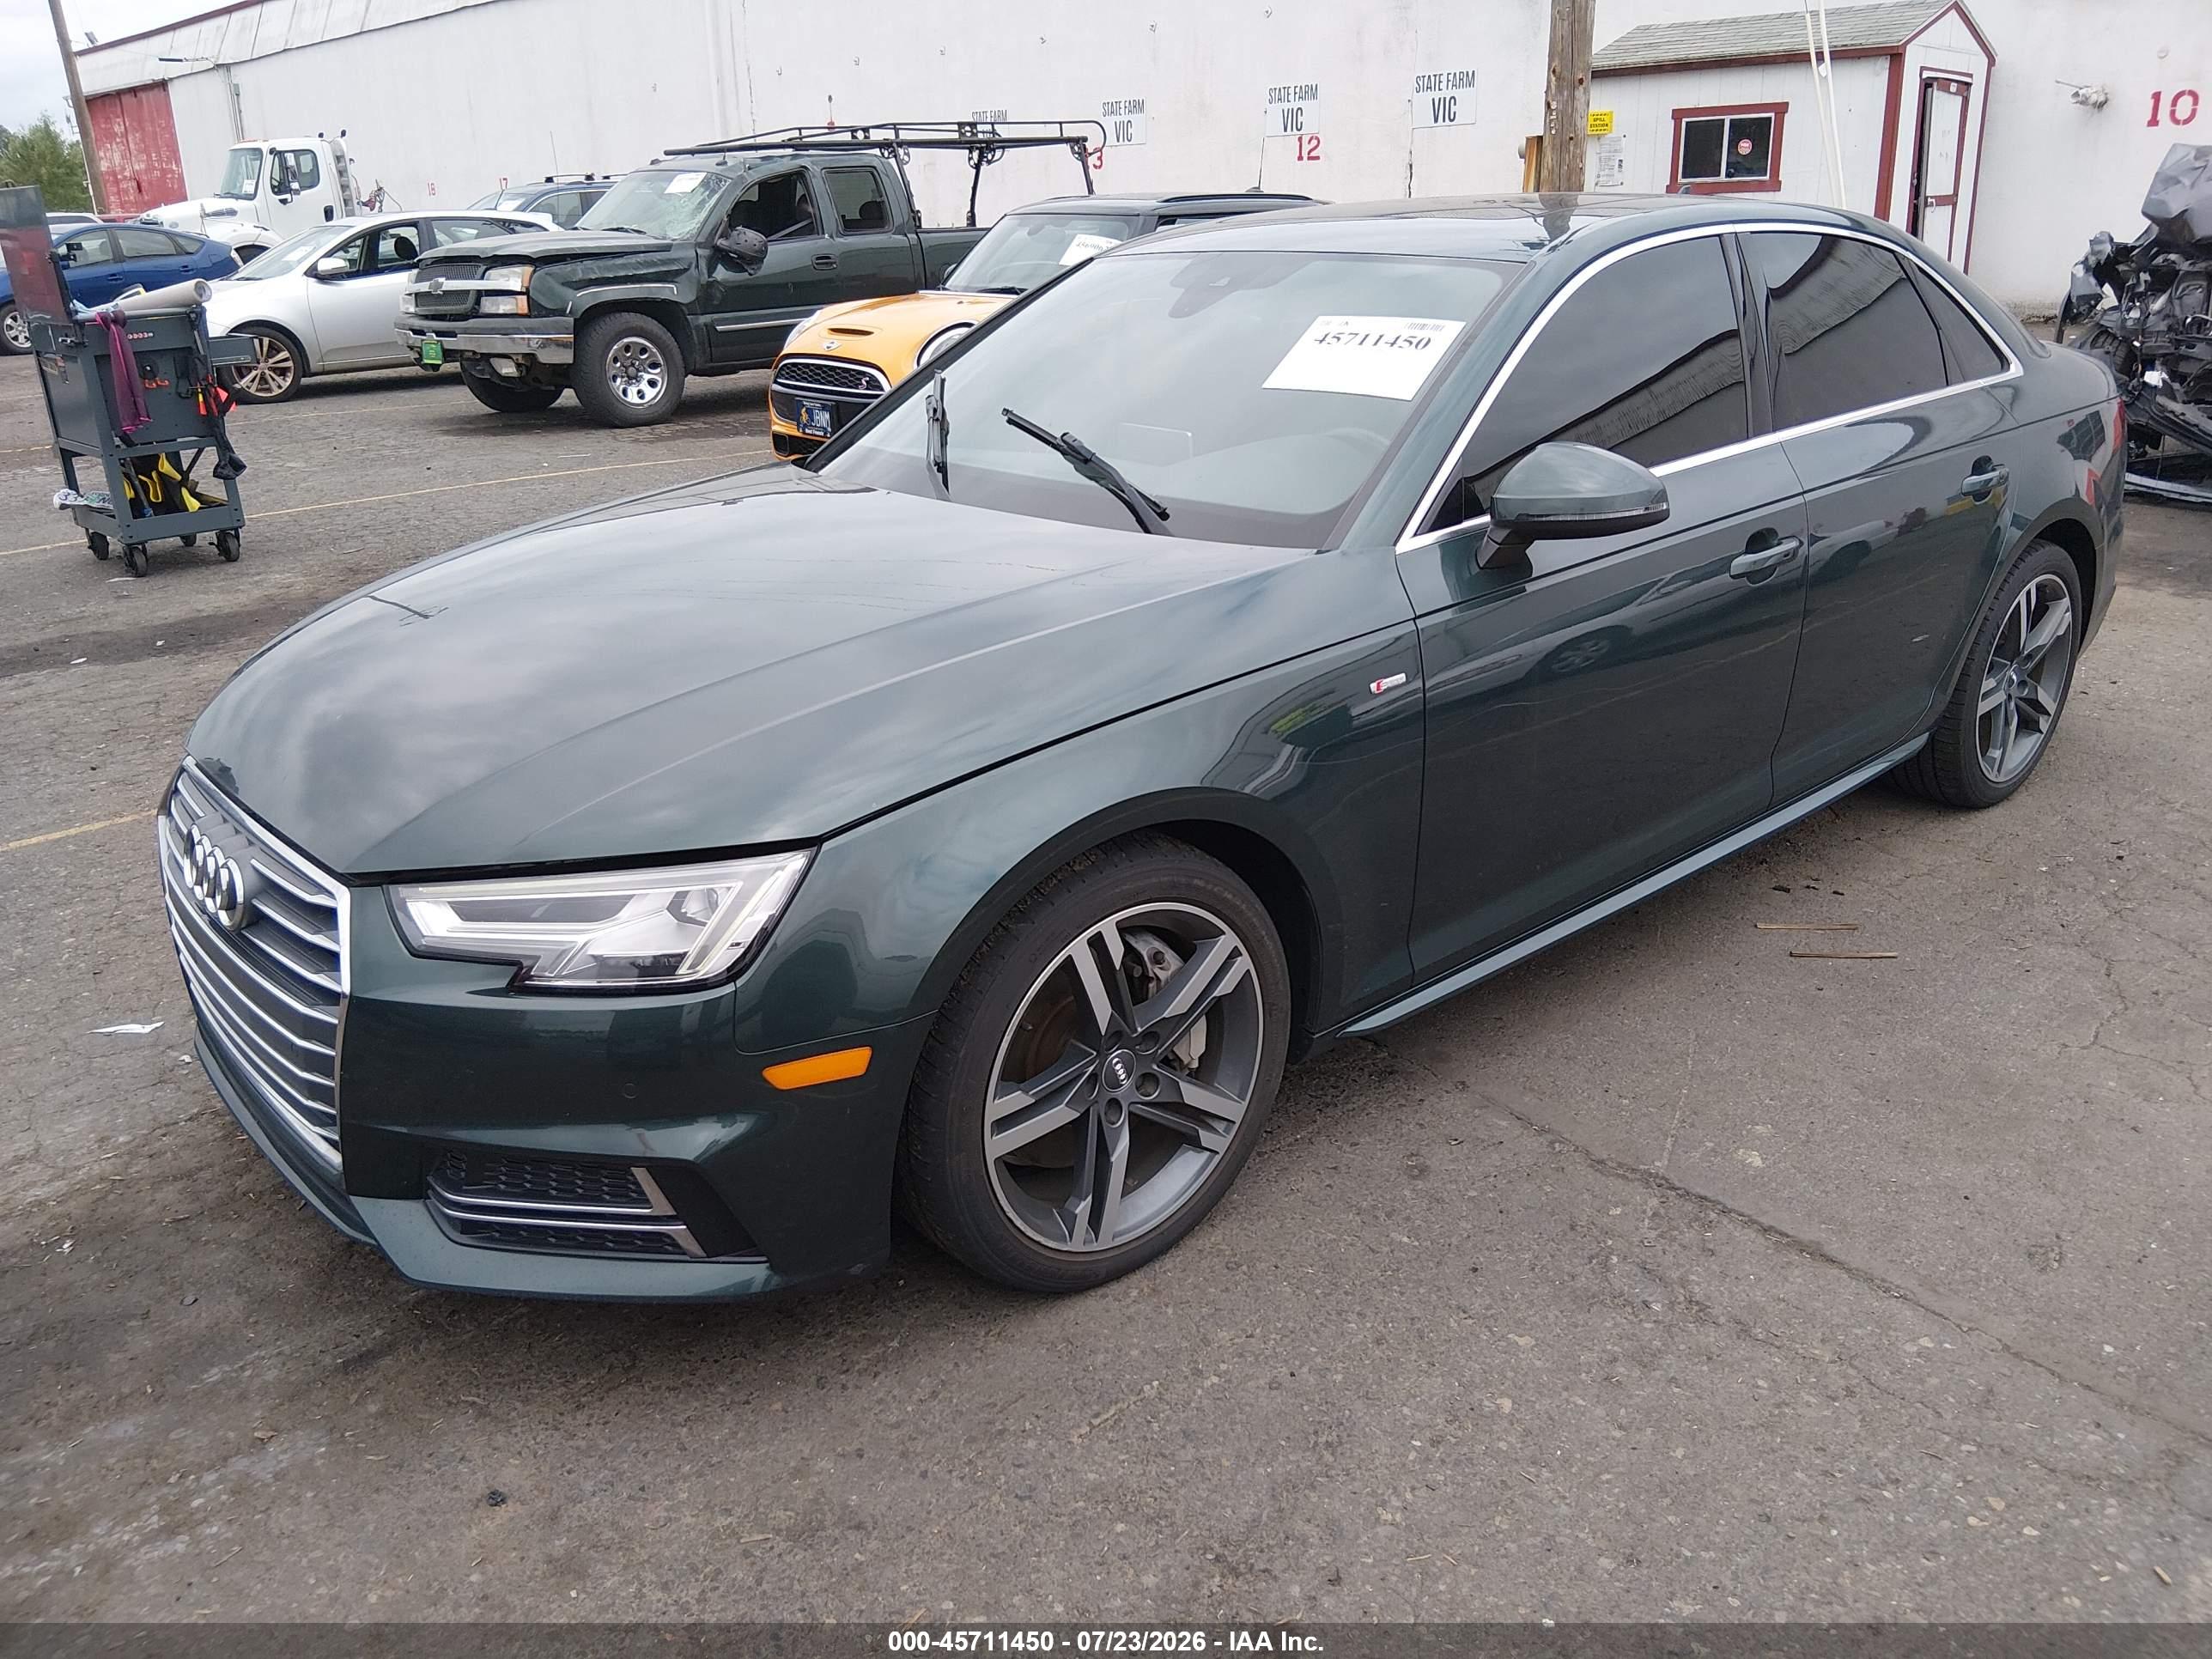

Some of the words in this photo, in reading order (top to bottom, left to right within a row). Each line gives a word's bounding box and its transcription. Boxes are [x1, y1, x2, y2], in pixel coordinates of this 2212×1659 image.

[1414, 73, 1443, 94] STATE
[1446, 70, 1475, 90] FARM
[1268, 86, 1291, 105] STATE
[1293, 83, 1318, 102] FARM
[989, 109, 1007, 122] FARM
[1102, 100, 1122, 118] STATE
[1123, 99, 1145, 116] FARM
[1281, 106, 1304, 132] VIC
[1431, 95, 1457, 124] VIC
[2147, 89, 2199, 127] 10
[1115, 119, 1133, 143] VIC
[1297, 135, 1321, 161] 12
[499, 177, 508, 190] 17
[1314, 331, 1432, 350] 45711450
[859, 376, 869, 389] S
[811, 409, 830, 428] JBNM
